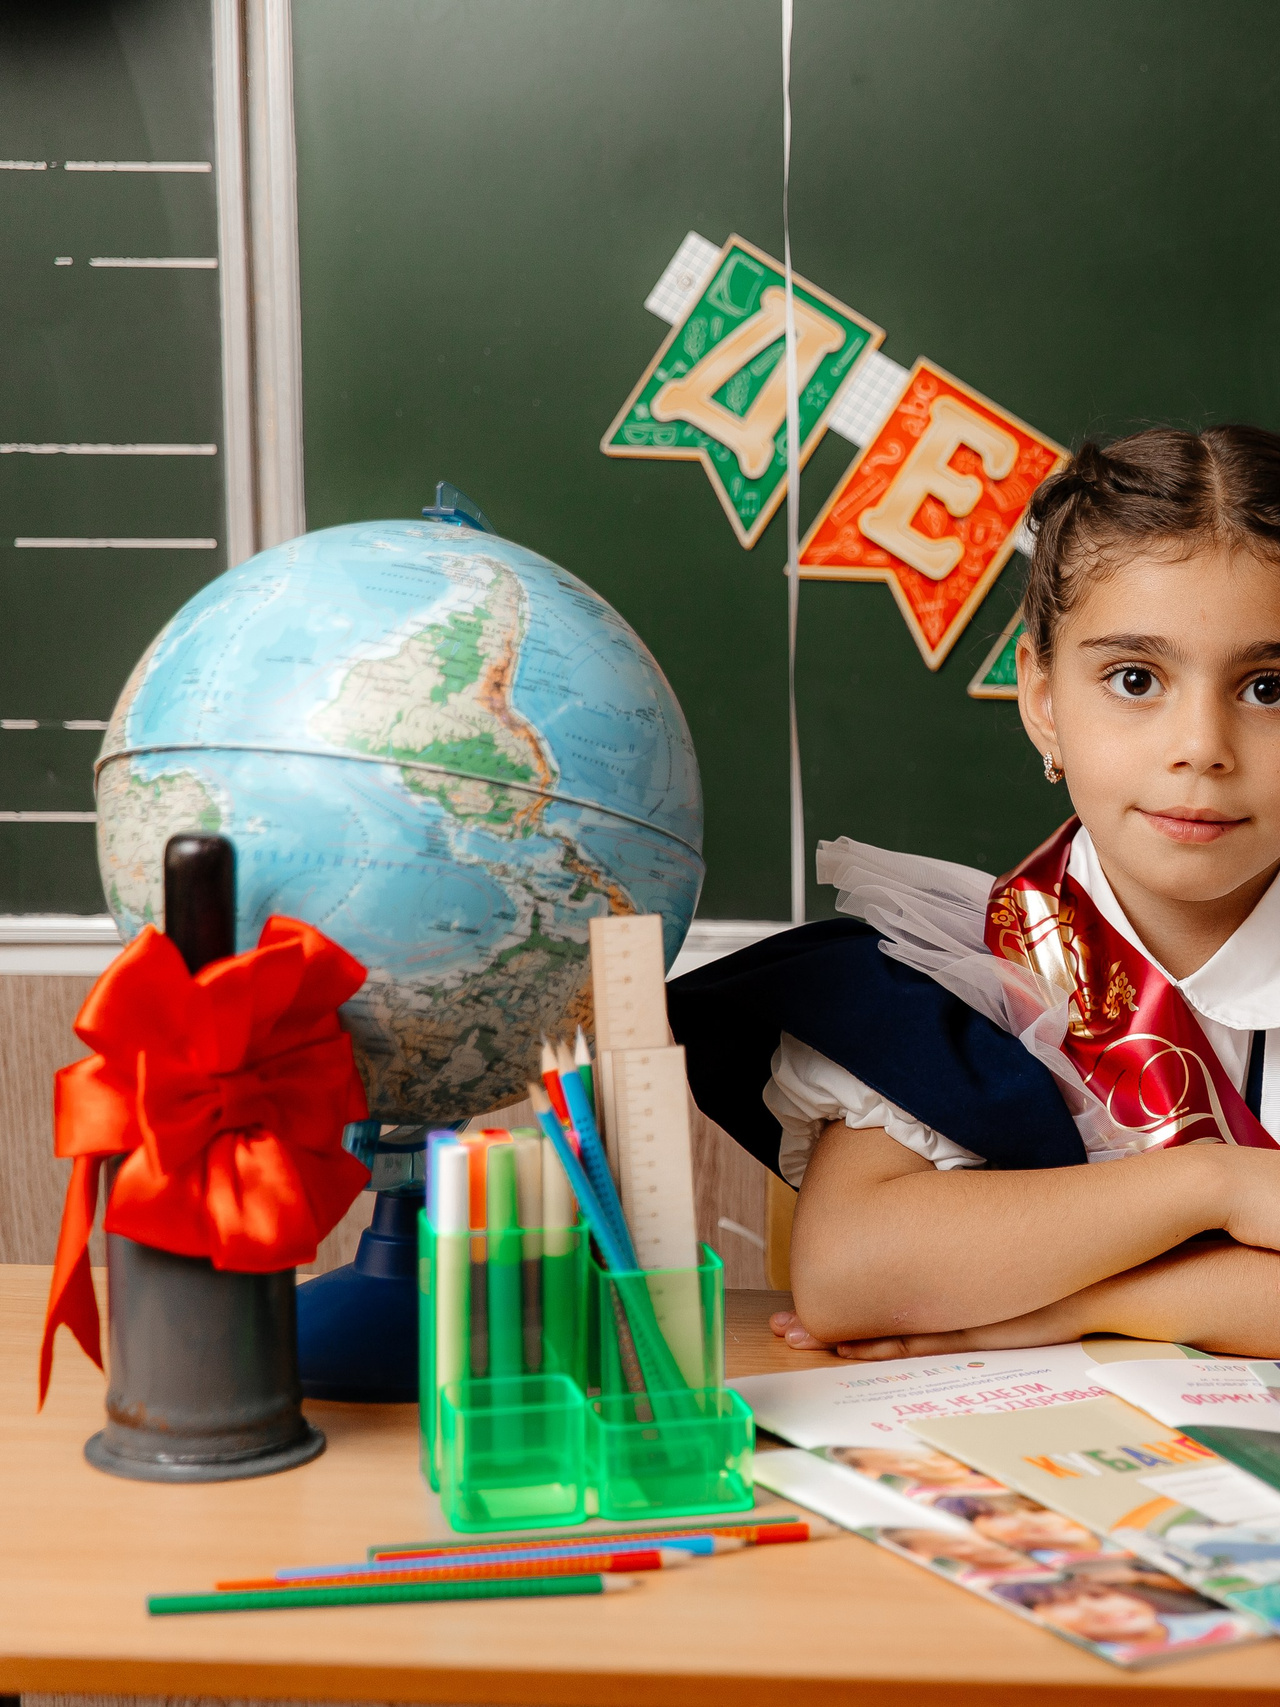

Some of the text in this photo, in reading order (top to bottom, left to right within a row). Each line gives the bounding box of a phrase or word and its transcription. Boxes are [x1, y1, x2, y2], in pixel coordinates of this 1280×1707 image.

[650, 285, 1020, 581] Д Е
[835, 1363, 966, 1389] ЗДОРОВЫЕ ДЕТИ
[994, 1368, 1052, 1382] ПИТАНИИ
[891, 1401, 948, 1416] ДВЕ
[946, 1382, 1053, 1408] НЕДЕЛИ
